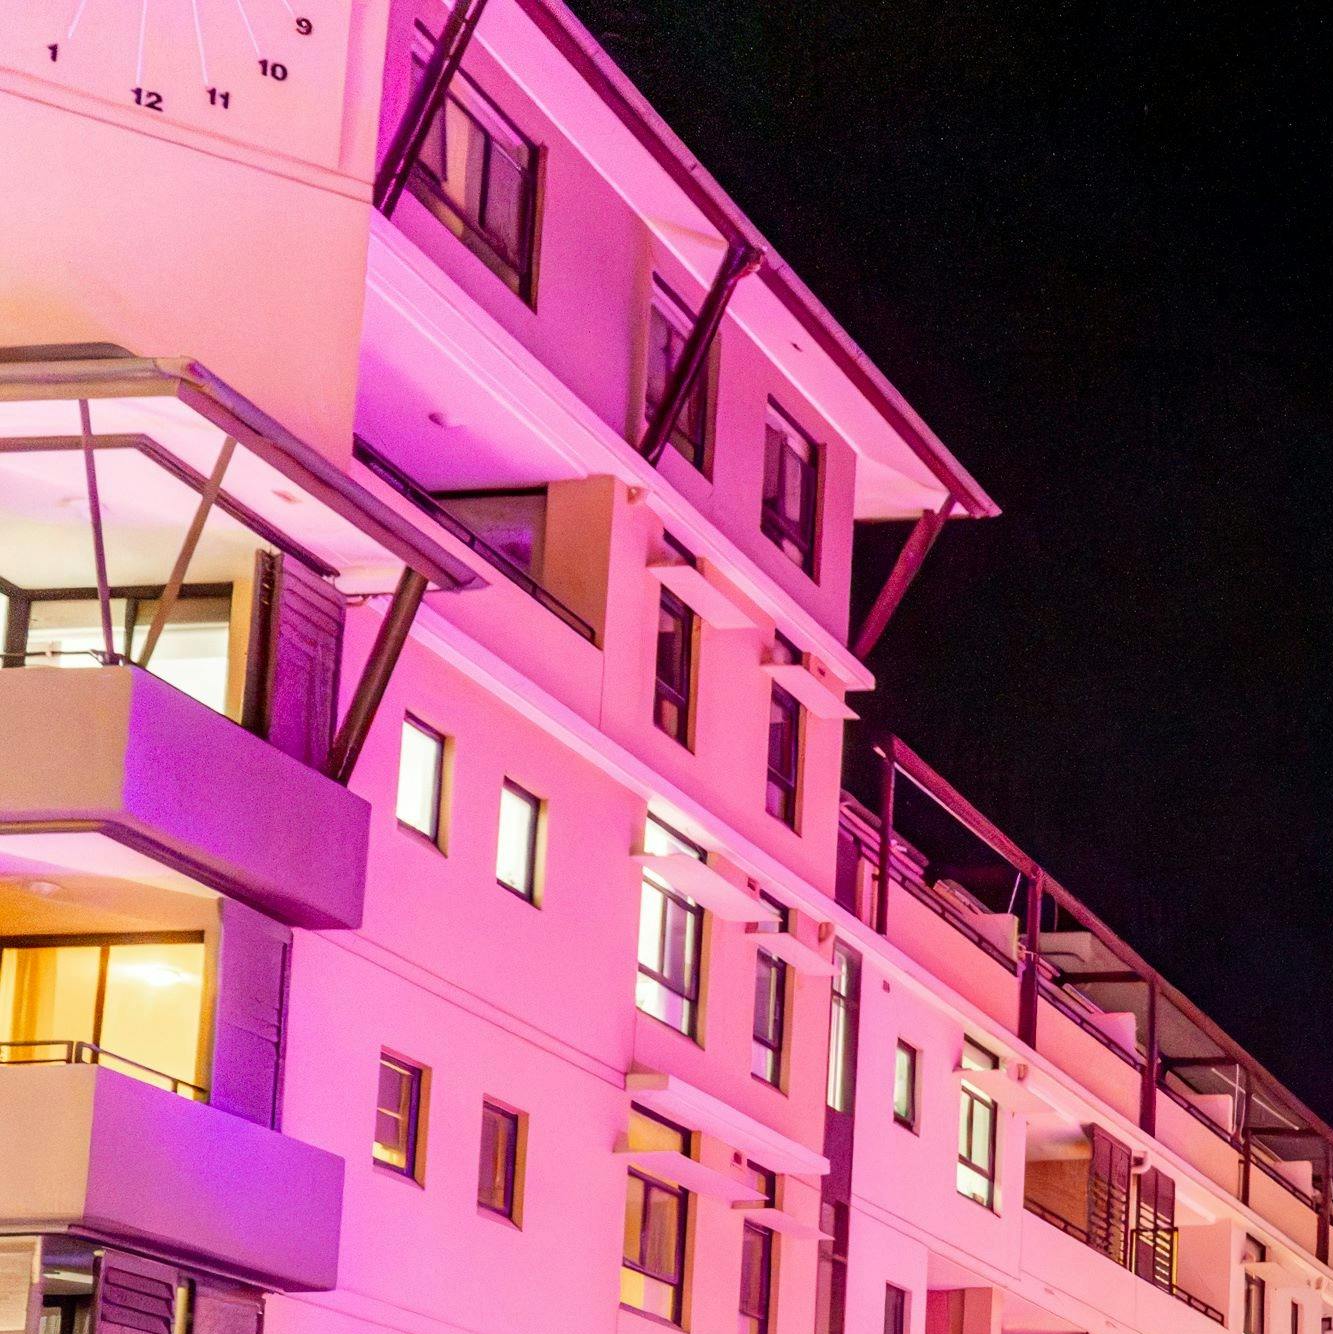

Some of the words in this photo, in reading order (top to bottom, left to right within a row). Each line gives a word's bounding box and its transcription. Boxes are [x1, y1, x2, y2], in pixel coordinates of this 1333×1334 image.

[295, 17, 313, 36] 9
[47, 43, 58, 62] 1
[258, 58, 288, 81] 10
[131, 87, 163, 112] 12
[206, 87, 230, 109] 11
